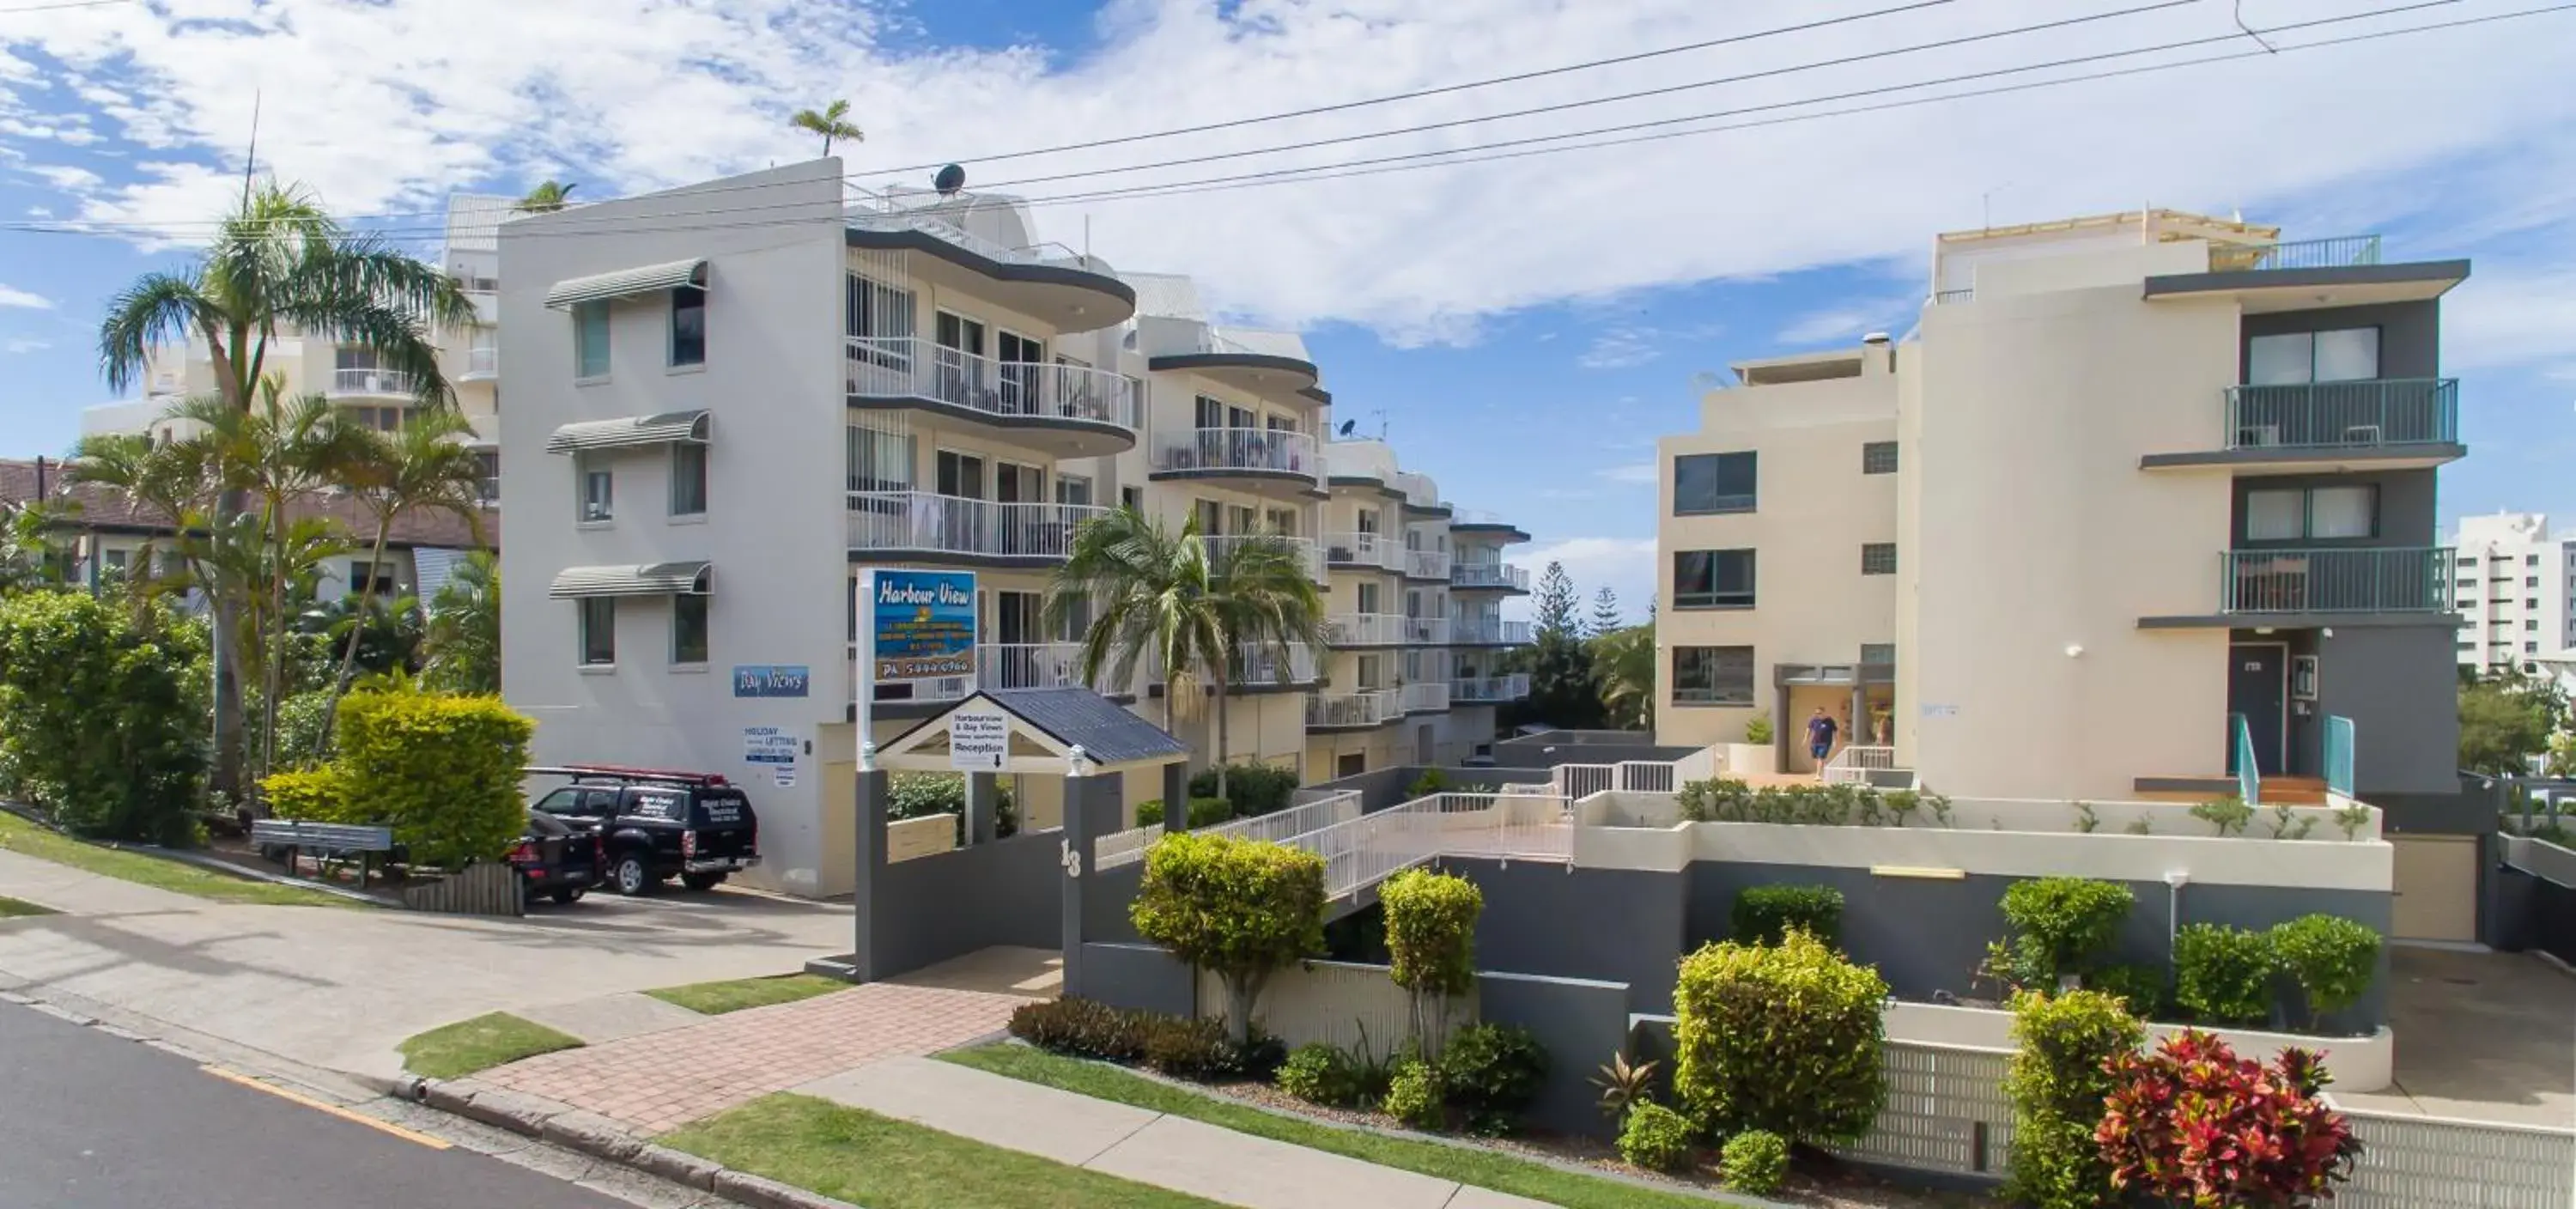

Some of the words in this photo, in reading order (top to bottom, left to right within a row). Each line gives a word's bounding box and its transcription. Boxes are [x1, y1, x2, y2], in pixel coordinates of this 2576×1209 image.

[879, 580, 935, 605] Harbour
[939, 581, 969, 605] View
[741, 670, 761, 696] Bay
[767, 670, 802, 690] Views
[744, 727, 779, 736] HOLIDAY
[963, 722, 978, 732] Bay
[981, 723, 1003, 732] Views
[954, 743, 1004, 755] Reception
[1061, 837, 1082, 878] 13
